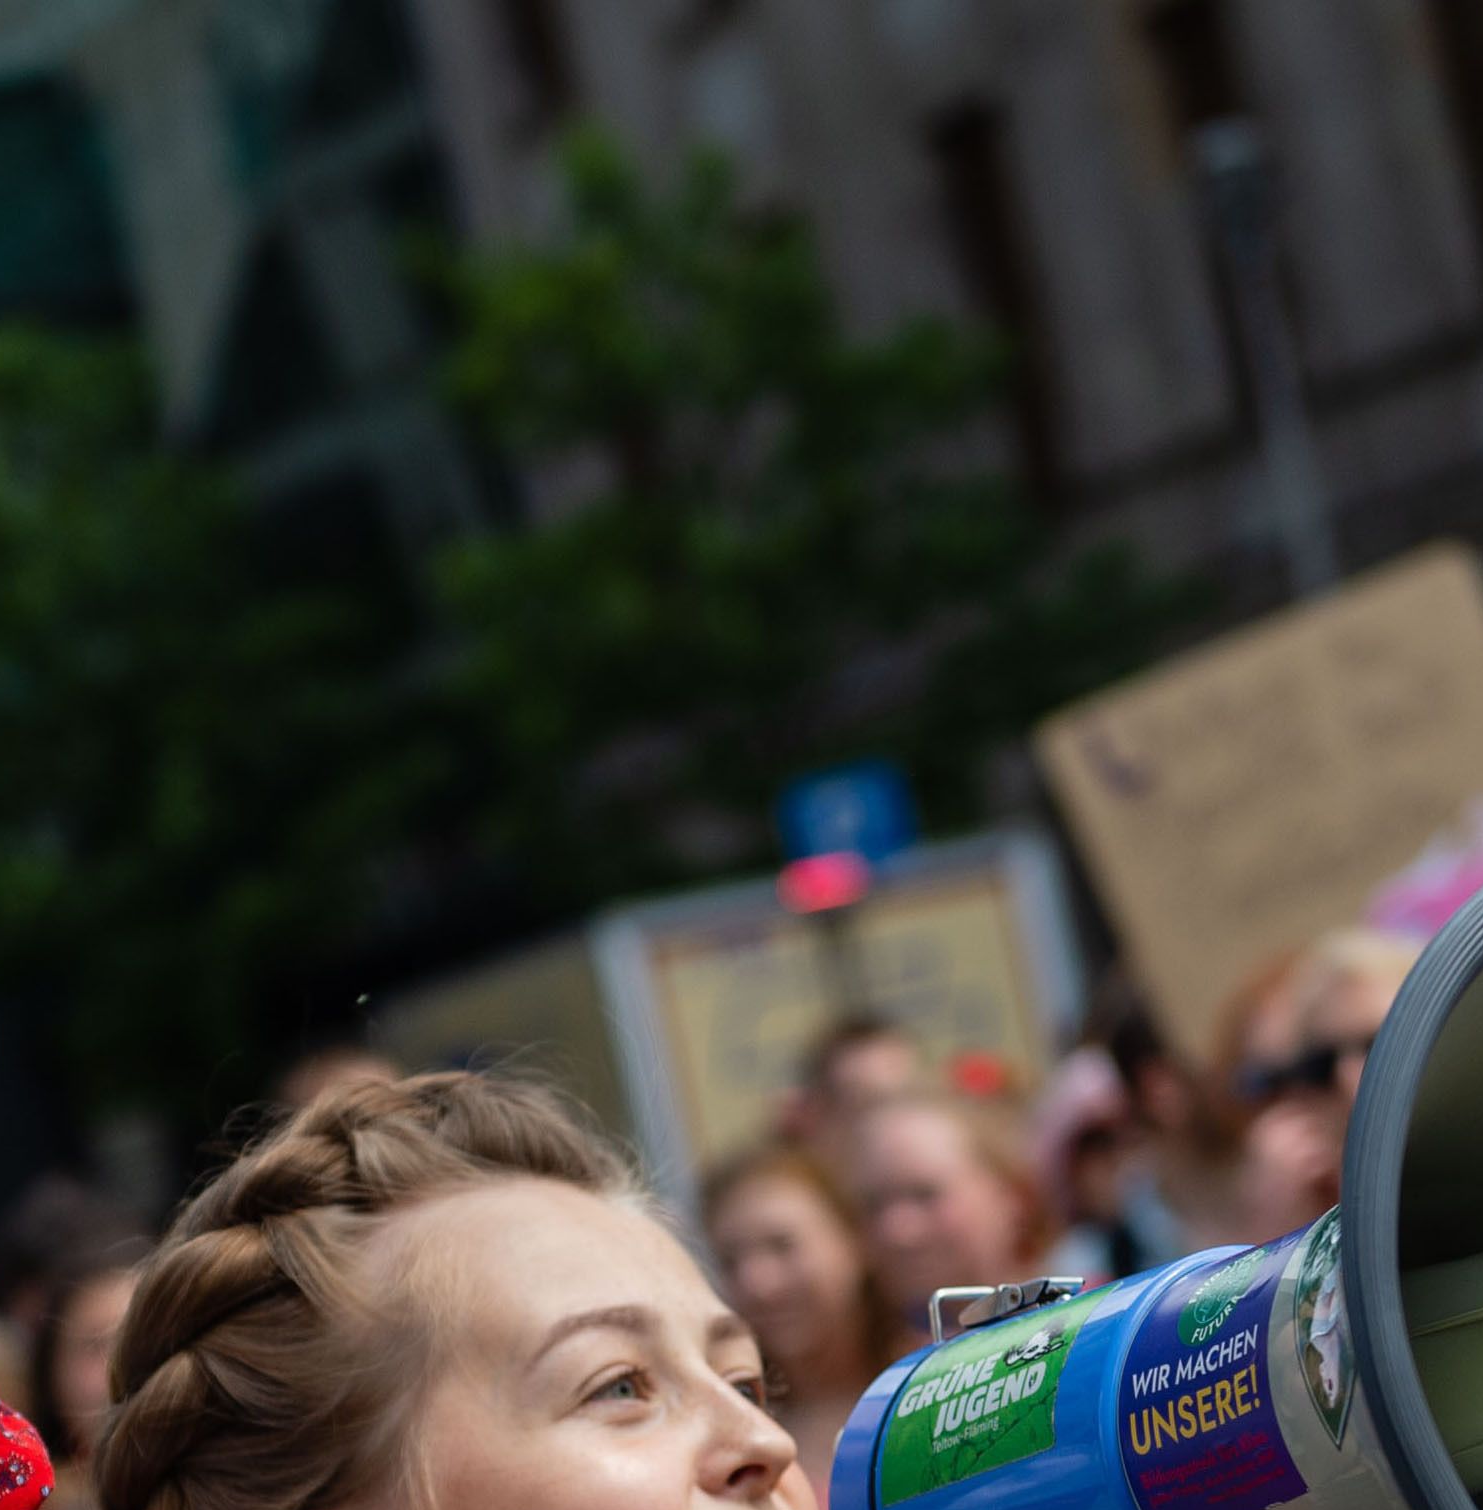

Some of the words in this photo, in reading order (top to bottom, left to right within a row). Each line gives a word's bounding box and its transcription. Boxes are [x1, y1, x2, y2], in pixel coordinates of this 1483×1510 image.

[933, 1361, 1047, 1438] JUGEND
[1132, 1363, 1171, 1399] WIR
[1175, 1323, 1259, 1386] MACHEN
[1129, 1363, 1261, 1456] UNSERE!
